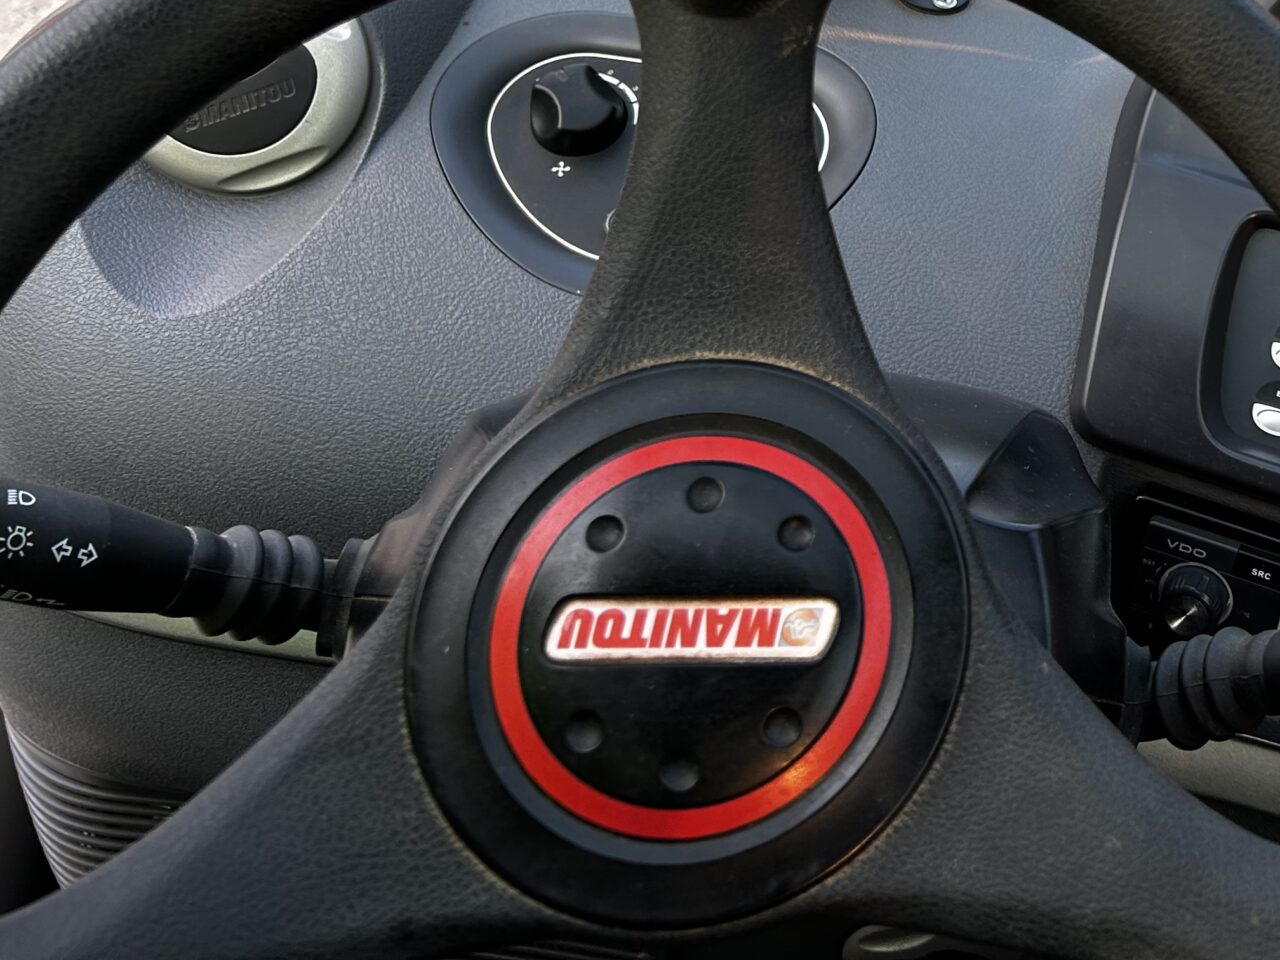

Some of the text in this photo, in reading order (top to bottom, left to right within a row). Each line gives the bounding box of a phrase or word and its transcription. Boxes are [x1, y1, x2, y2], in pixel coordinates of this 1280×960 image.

[203, 77, 296, 128] MANITOU
[1166, 538, 1207, 559] VDO
[1251, 567, 1272, 582] SRC
[557, 605, 783, 651] MANITOU
